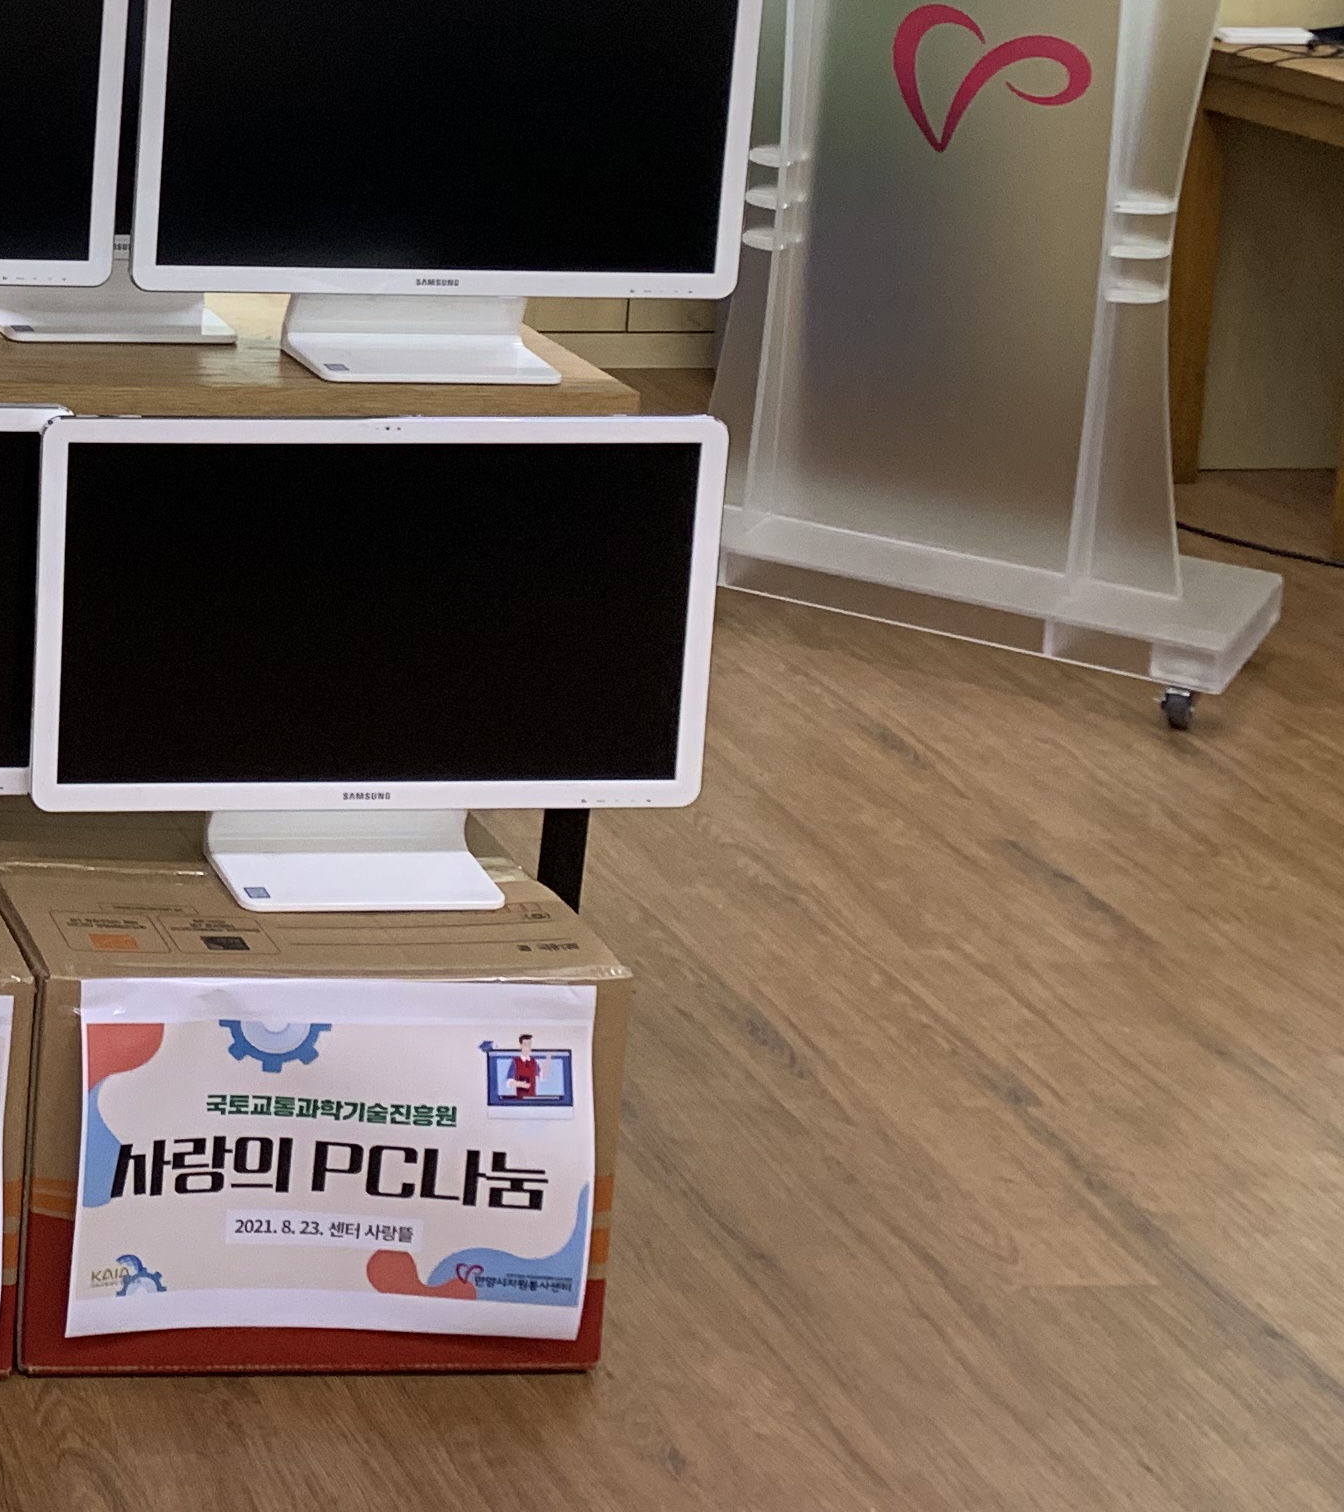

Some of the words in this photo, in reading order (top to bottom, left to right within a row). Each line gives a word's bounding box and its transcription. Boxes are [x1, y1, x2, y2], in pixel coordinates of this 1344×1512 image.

[415, 278, 460, 287] SAMSUNG
[342, 791, 391, 801] SAMSUNG
[205, 1093, 458, 1128] 국토교통과학기술진흥원
[109, 1134, 294, 1199] 사랑의
[310, 1140, 549, 1212] PC나눔
[234, 1219, 277, 1235] 2021.
[280, 1219, 296, 1235] 8.
[299, 1220, 324, 1236] 23.
[328, 1221, 361, 1240] 센터
[90, 1266, 130, 1282] KAIA
